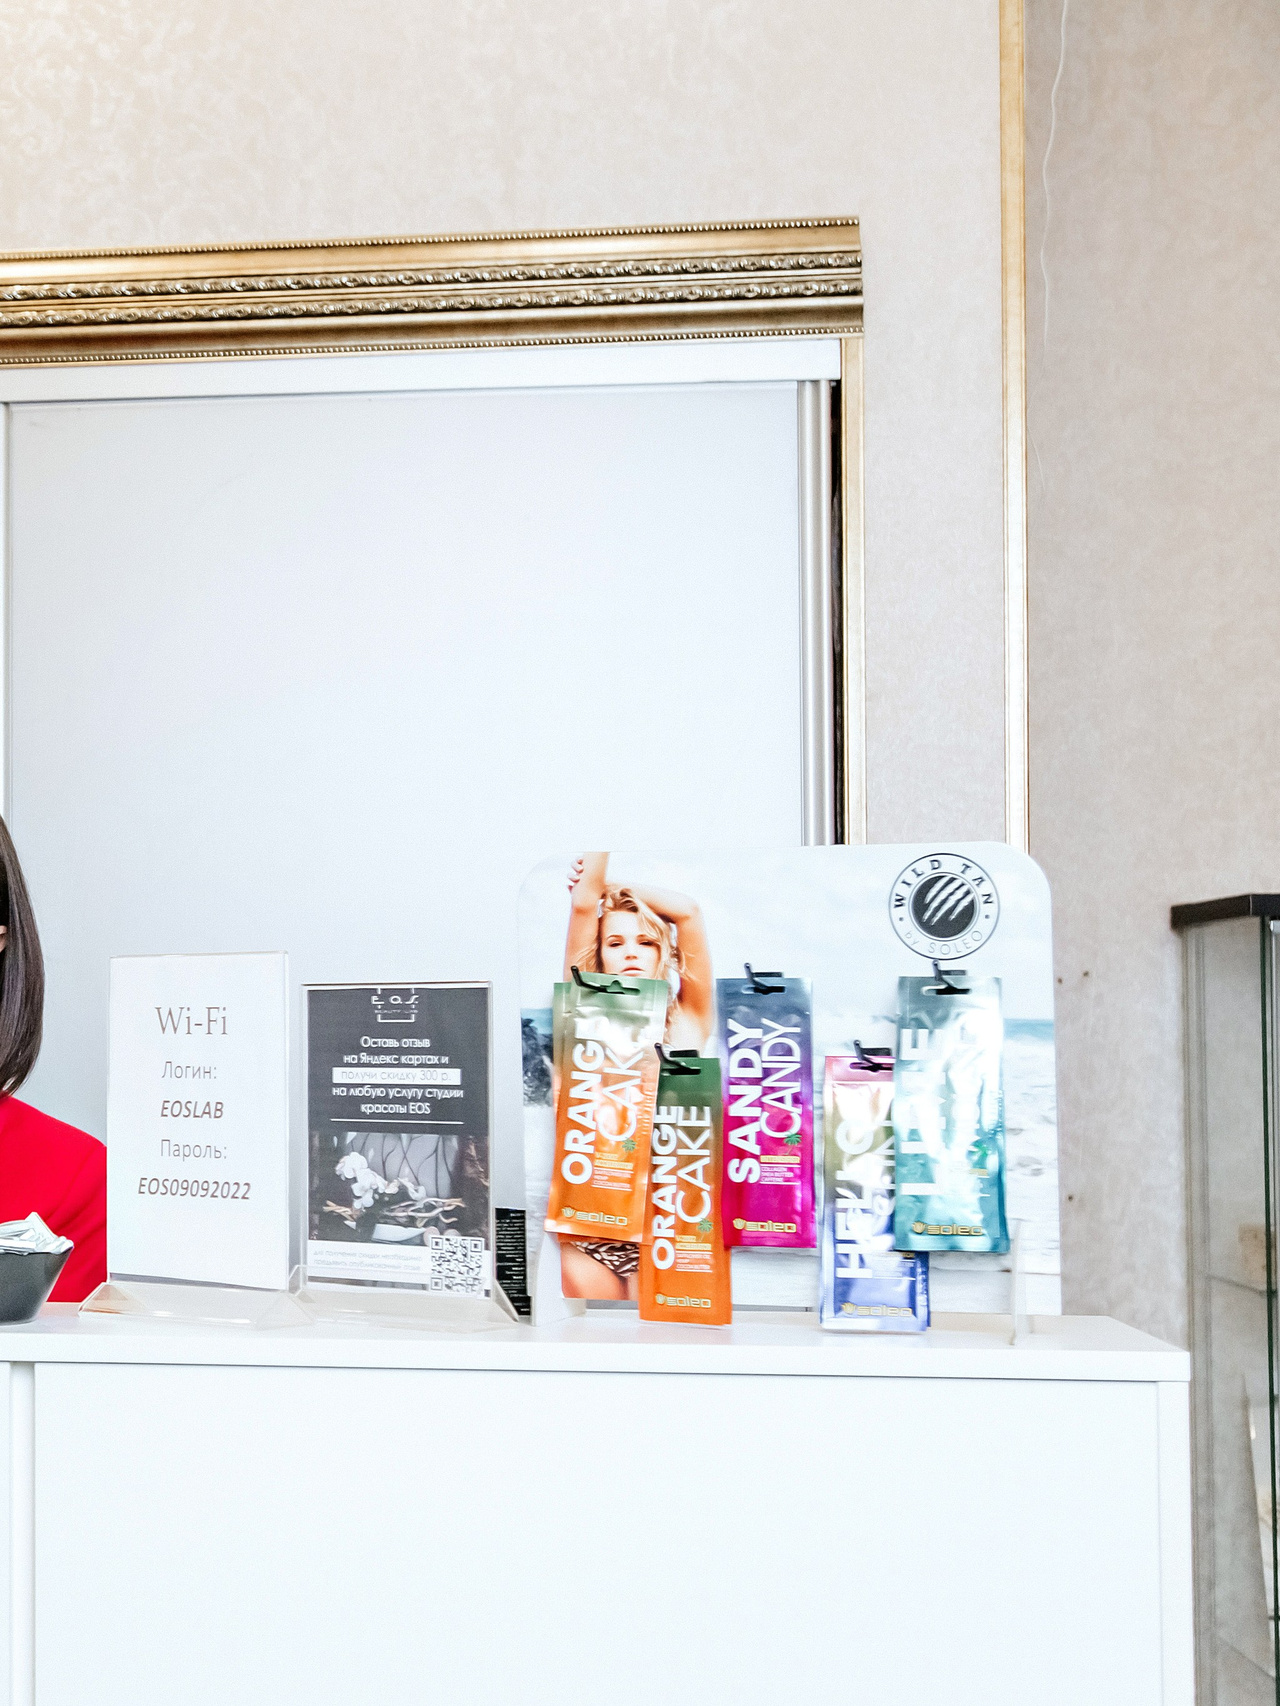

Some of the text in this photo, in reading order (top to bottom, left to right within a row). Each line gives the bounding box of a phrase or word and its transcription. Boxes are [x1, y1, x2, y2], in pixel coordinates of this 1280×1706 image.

[894, 859, 994, 909] WILD TAN
[904, 930, 982, 956] by SOLEO
[154, 1006, 228, 1035] Wi-Fi
[360, 1036, 431, 1048] Оставь отзыв
[343, 1053, 449, 1066] на Яндекс картах и
[161, 1061, 218, 1079] Логин:
[341, 1070, 378, 1082] получи
[380, 1071, 417, 1082] скидку
[419, 1068, 438, 1081] 300
[760, 1017, 802, 1138] CANDY
[332, 1085, 464, 1100] на любую услугу студии
[727, 1018, 763, 1184] SANDY
[160, 1100, 224, 1119] EOSLAB
[360, 1102, 431, 1115] красоты EOS
[160, 1139, 227, 1161] Пароль:
[676, 1106, 711, 1223] CAKE
[138, 1177, 251, 1200] EOS09092022
[651, 1106, 678, 1270] ORANGE
[576, 1211, 628, 1226] soleo
[745, 1220, 797, 1233] soleo
[926, 1223, 984, 1236] soleo
[666, 1295, 712, 1309] soleo
[857, 1305, 913, 1317] soleo
